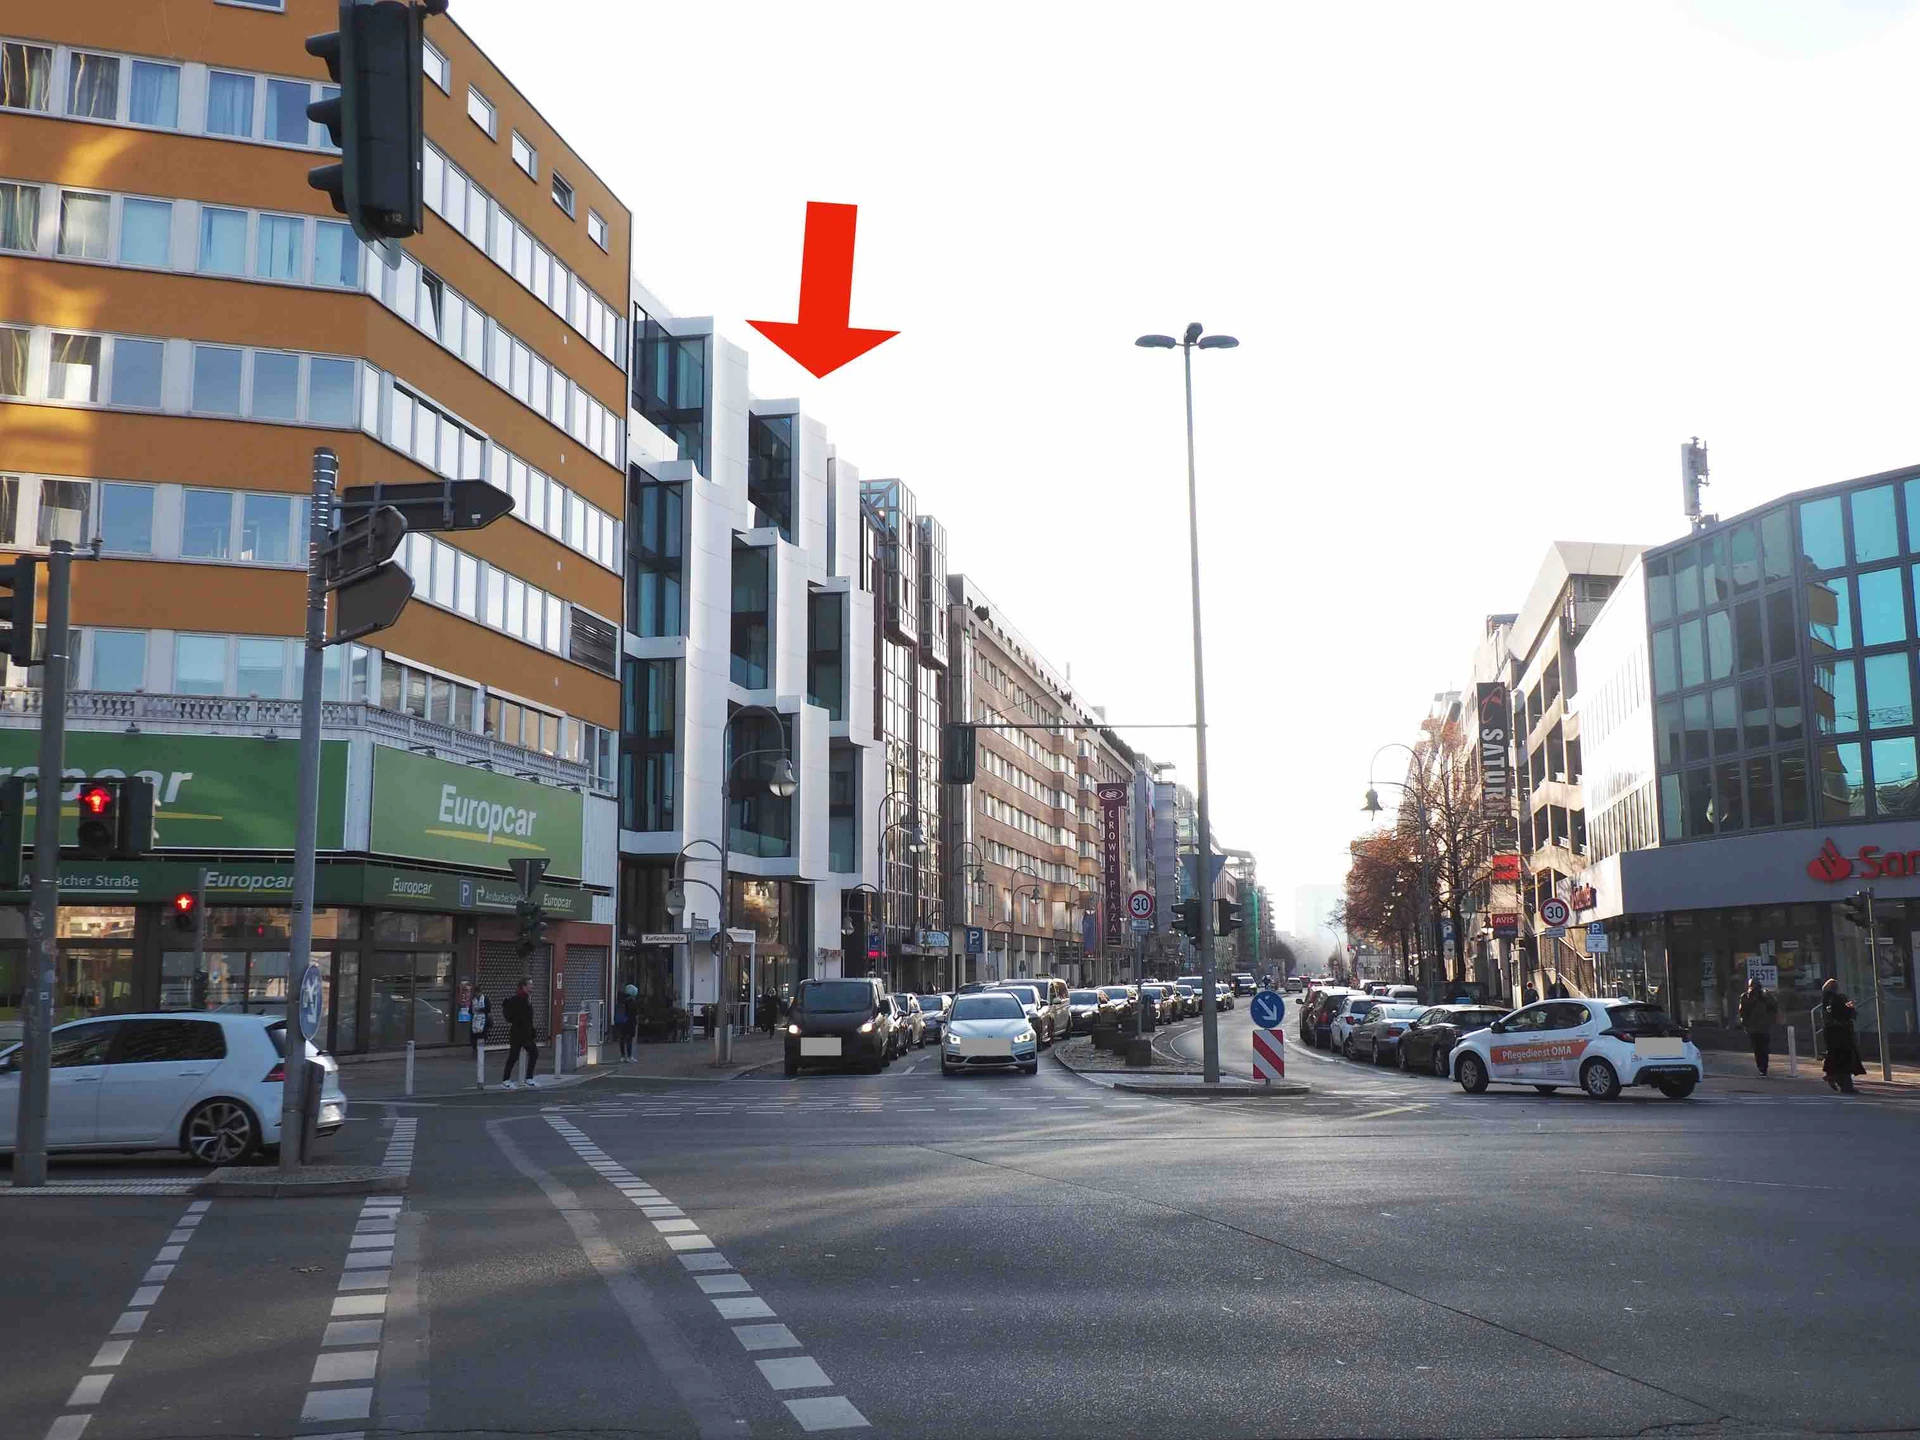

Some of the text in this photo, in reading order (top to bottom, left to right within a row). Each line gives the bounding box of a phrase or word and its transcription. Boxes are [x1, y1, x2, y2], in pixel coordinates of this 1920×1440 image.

[439, 784, 537, 843] Europcar
[1108, 809, 1117, 873] CROWNE
[22, 873, 139, 887] Aacher Straße
[204, 872, 294, 892] Europcar
[392, 877, 432, 898] Europcar
[462, 884, 470, 902] P
[543, 893, 572, 909] Europcar
[1109, 879, 1117, 933] PLAZA
[1133, 898, 1149, 911] 30
[1495, 916, 1515, 924] AVIS
[1546, 909, 1564, 920] 30
[969, 930, 980, 945] P
[1502, 1045, 1572, 1061] Pflegedienst OMA
